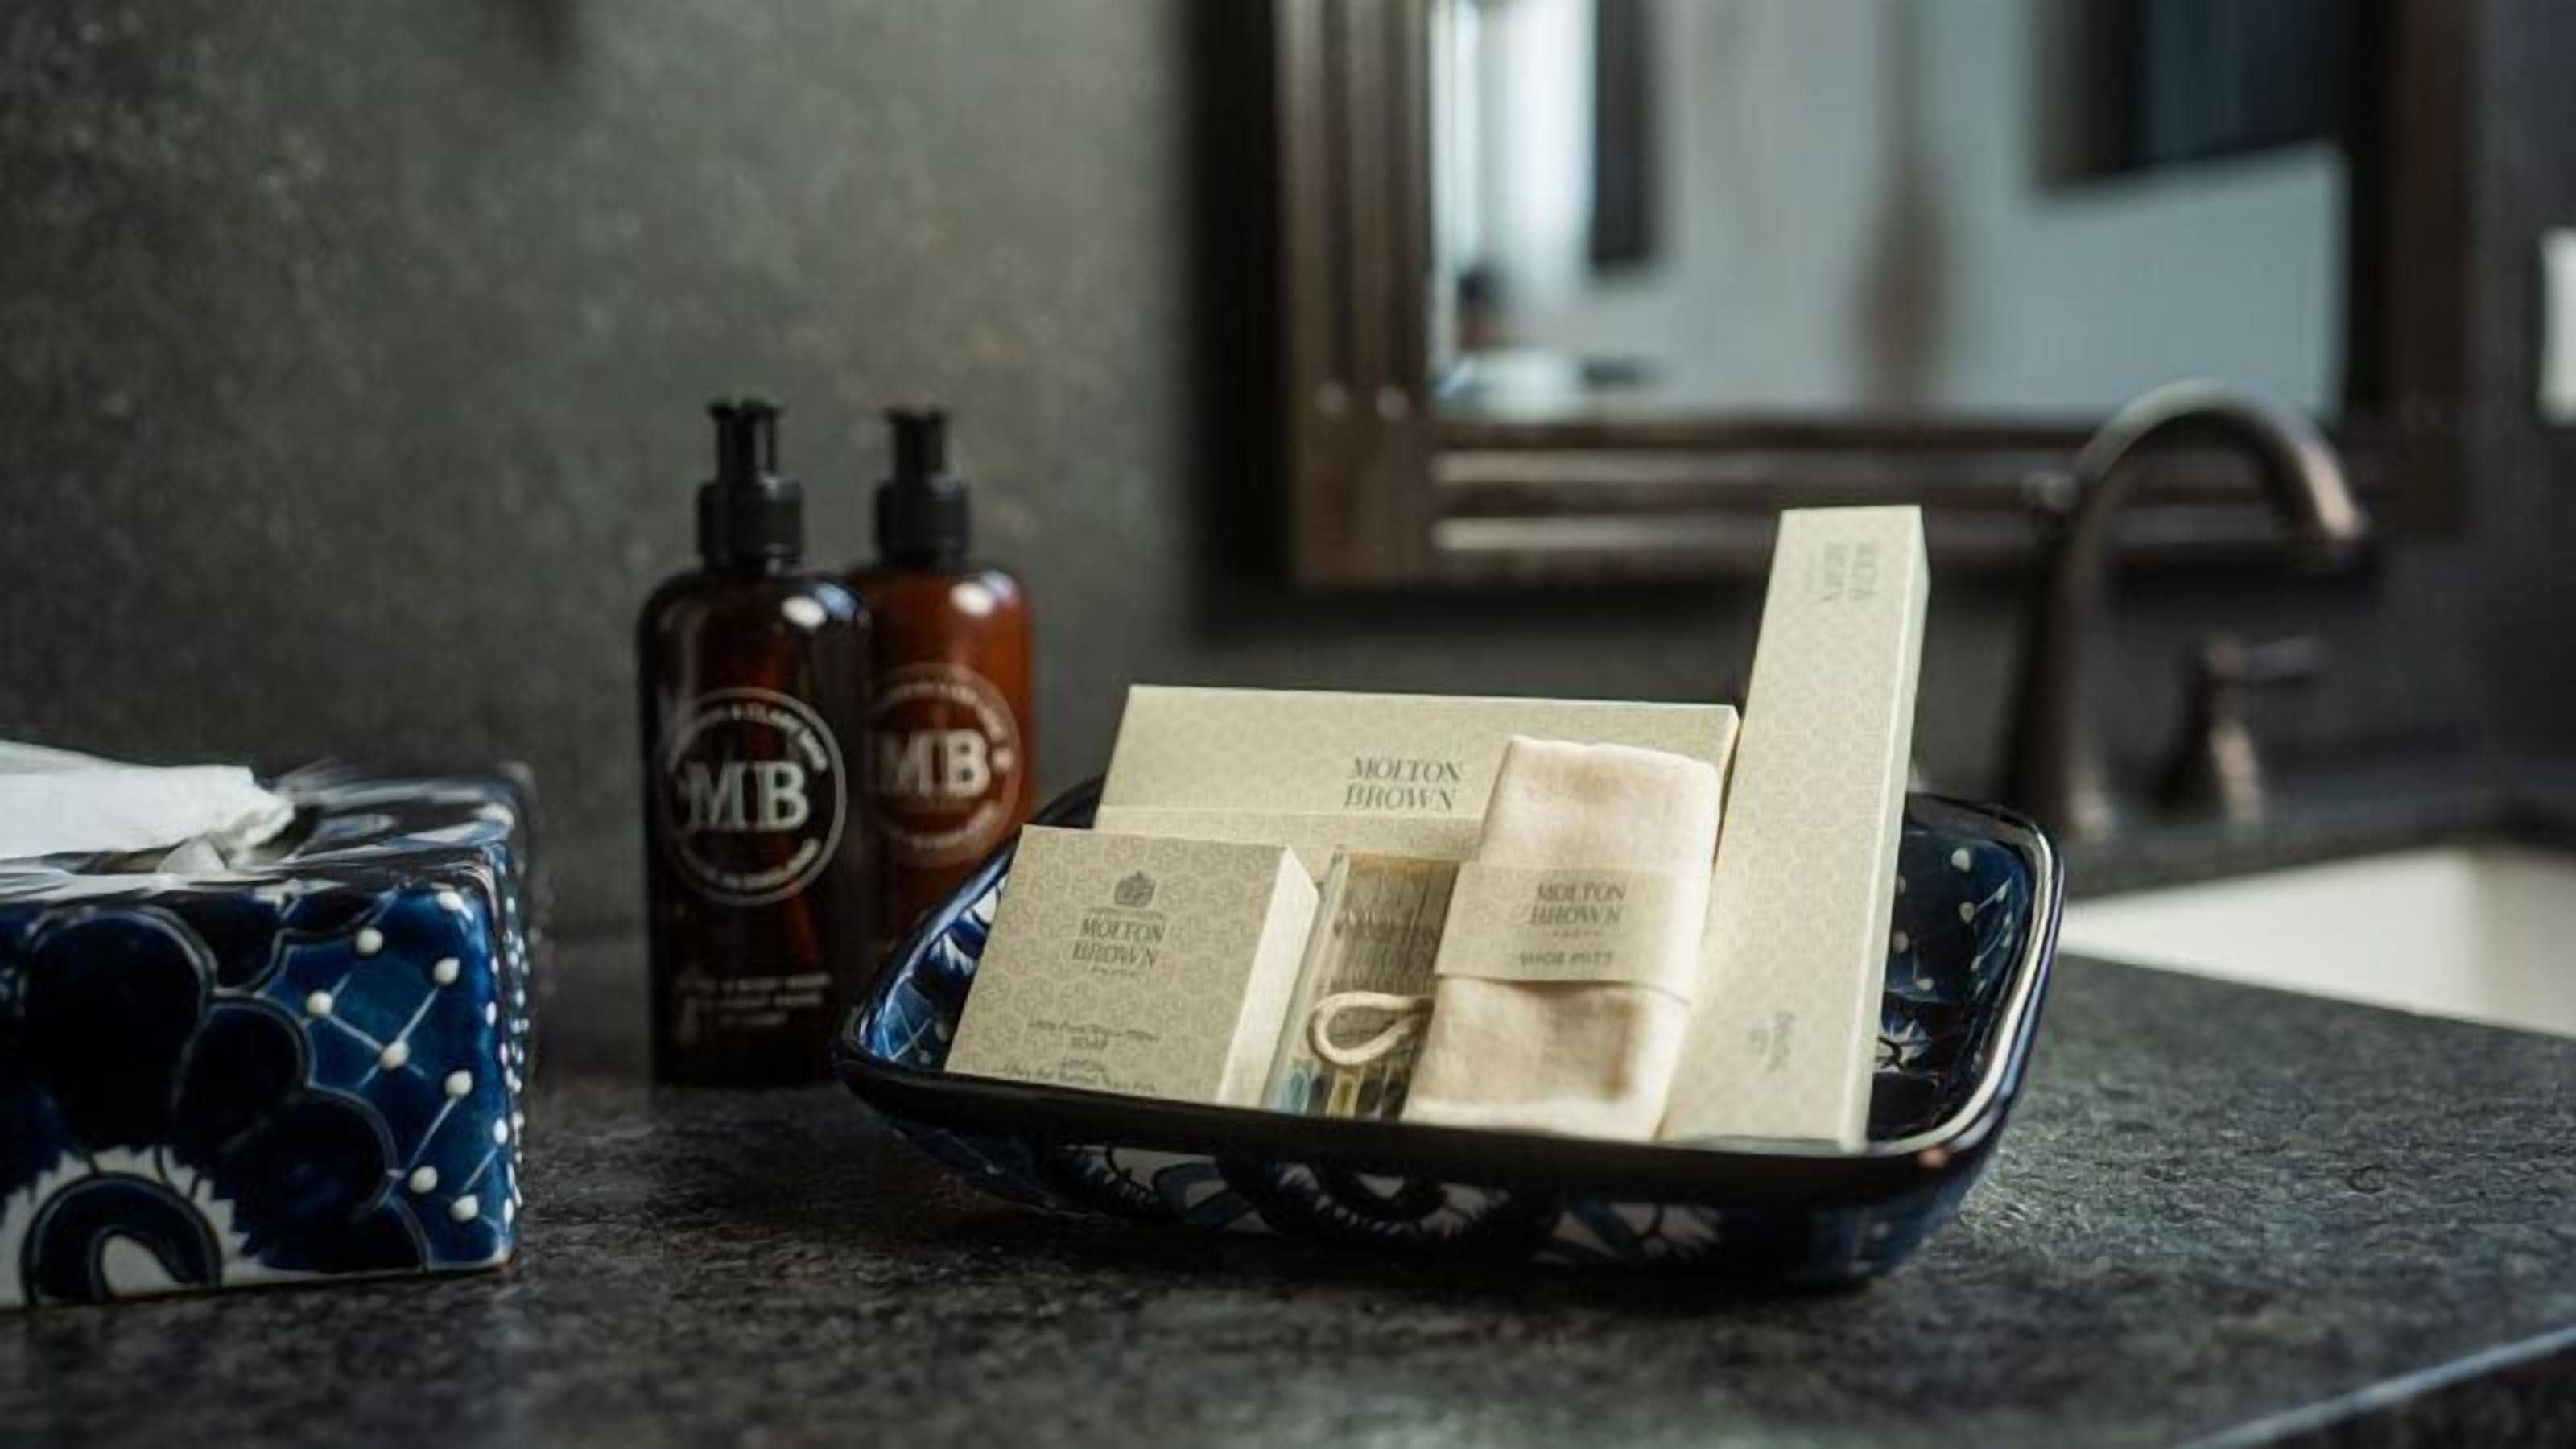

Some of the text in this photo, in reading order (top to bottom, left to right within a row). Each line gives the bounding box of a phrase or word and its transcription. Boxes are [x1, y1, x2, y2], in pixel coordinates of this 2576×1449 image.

[876, 728, 992, 799] MB
[1352, 756, 1462, 783] MOLTON
[683, 759, 811, 832] MB
[1344, 784, 1454, 811] BROWN
[1536, 882, 1628, 903] MOLTON
[1529, 905, 1624, 926] BROWN
[1080, 916, 1166, 943] MOLTON
[1072, 941, 1158, 967] BROWN
